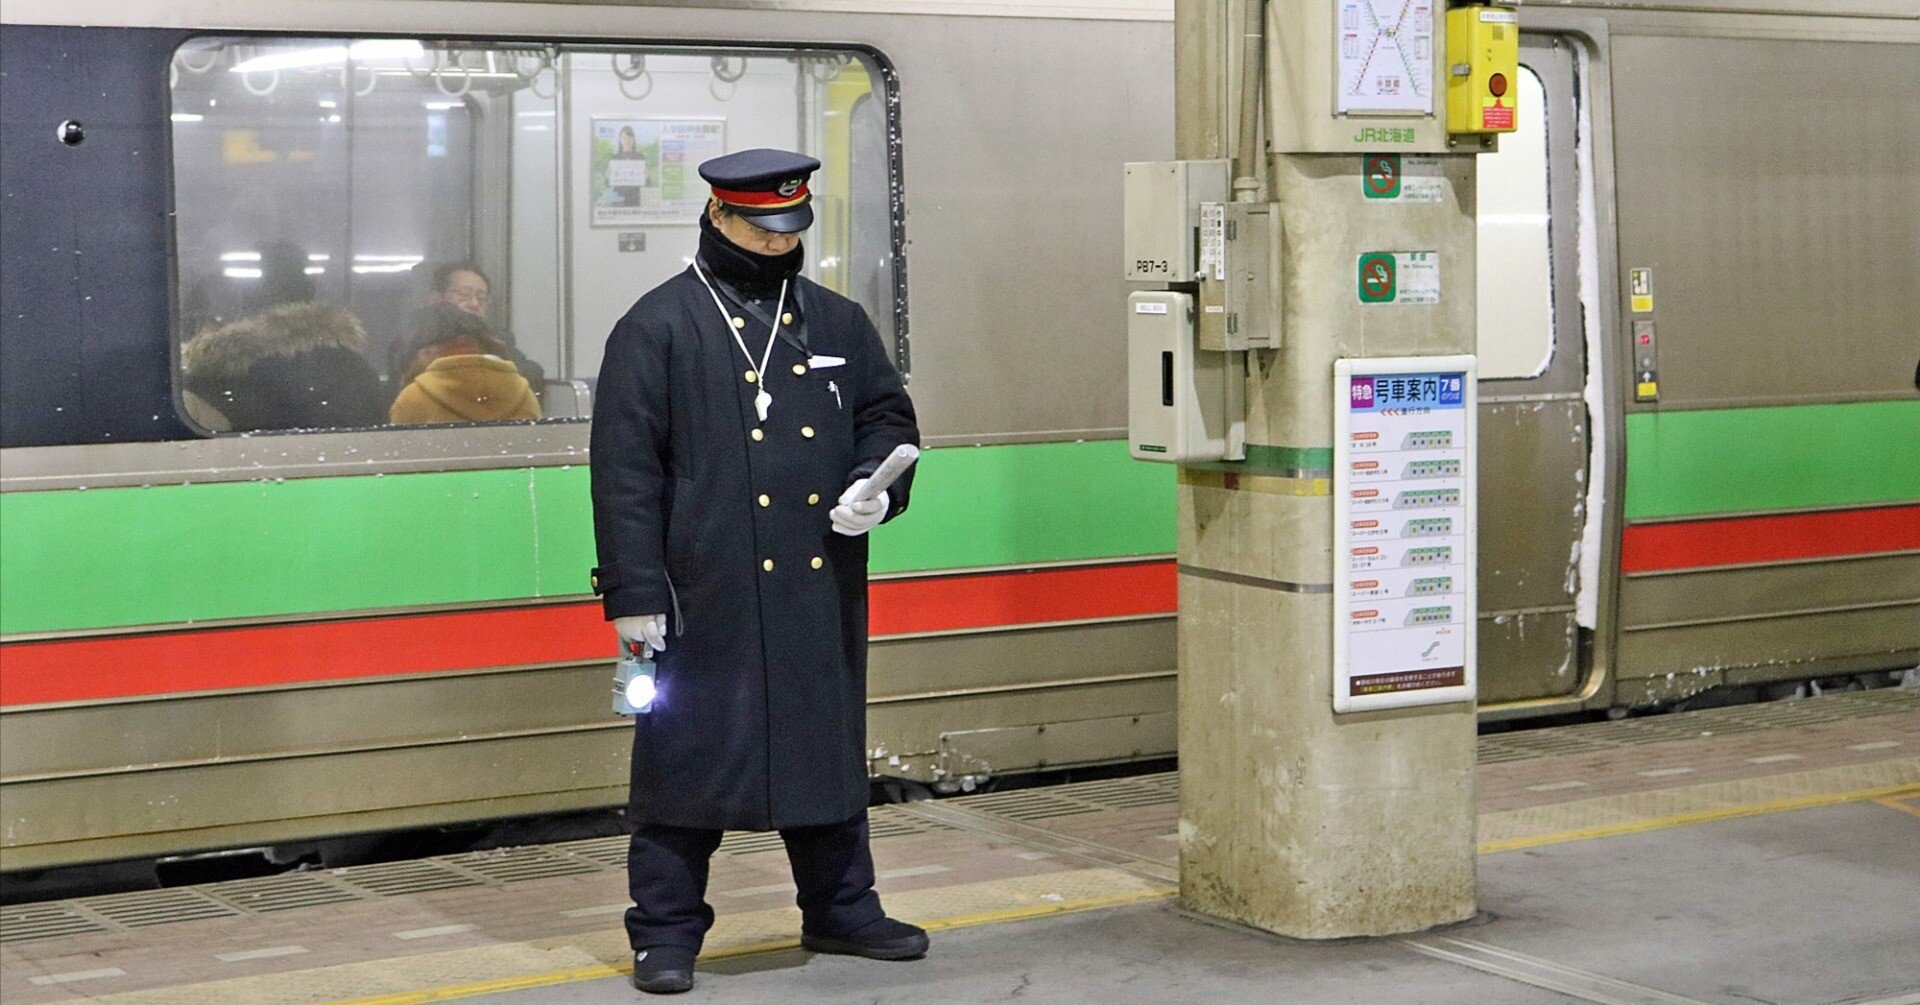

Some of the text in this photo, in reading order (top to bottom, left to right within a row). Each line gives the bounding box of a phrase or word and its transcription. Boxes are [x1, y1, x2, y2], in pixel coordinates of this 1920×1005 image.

[1354, 127, 1415, 144] JR北海道
[1136, 260, 1169, 273] PB7-3
[1351, 384, 1373, 400] 特急
[1375, 378, 1437, 404] 号車案内
